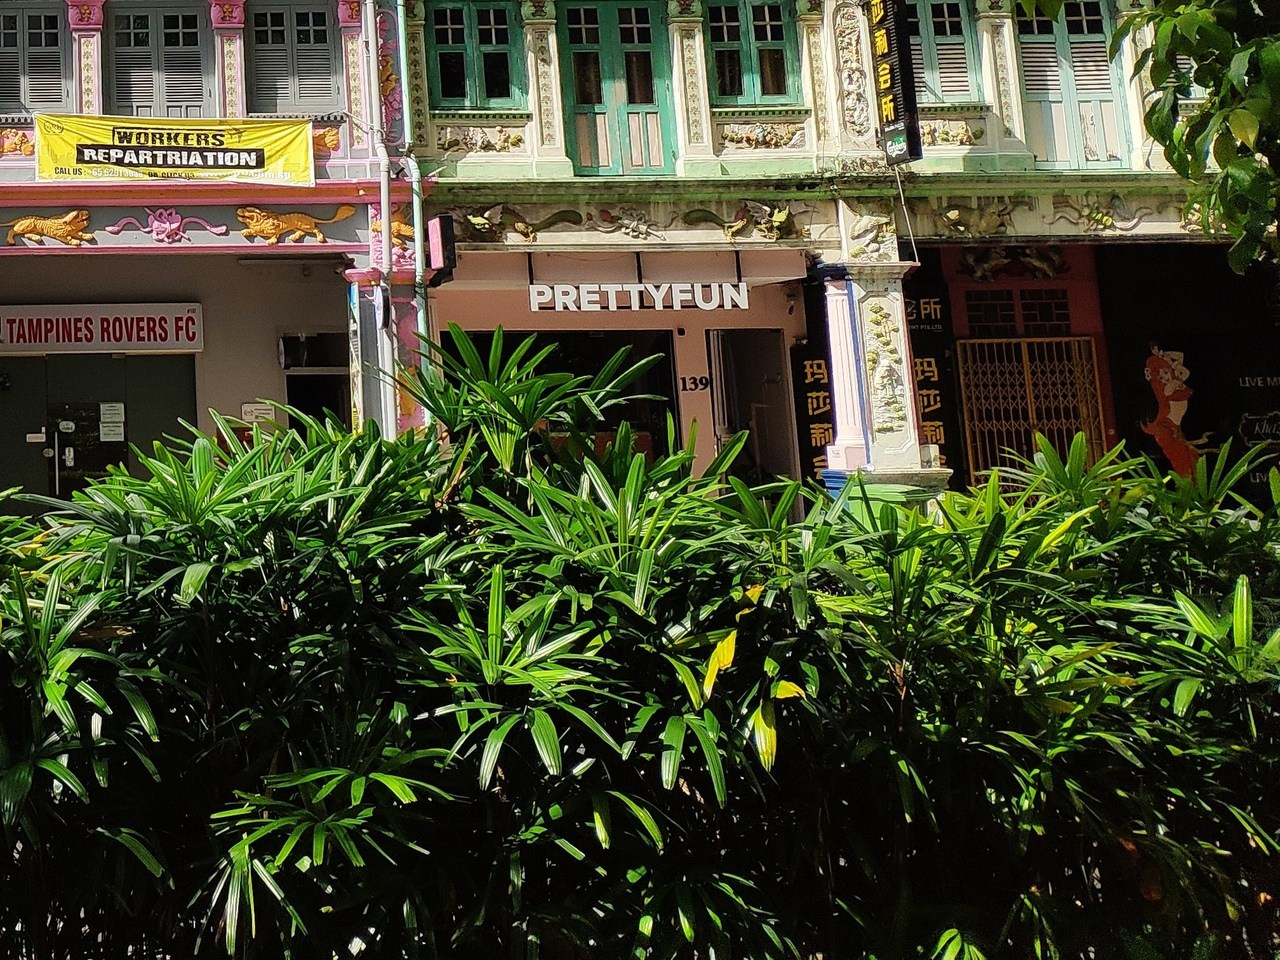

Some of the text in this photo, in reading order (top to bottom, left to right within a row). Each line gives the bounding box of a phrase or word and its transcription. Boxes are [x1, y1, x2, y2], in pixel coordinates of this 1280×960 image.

[116, 131, 225, 147] WORKERS
[83, 148, 257, 167] REPARTRIATION
[54, 166, 71, 176] CALL
[528, 282, 750, 312] PRETTYFUN
[6, 315, 197, 344] TAMPINES ROVERS FC
[680, 376, 709, 392] 139
[1238, 376, 1265, 387] LIVE
